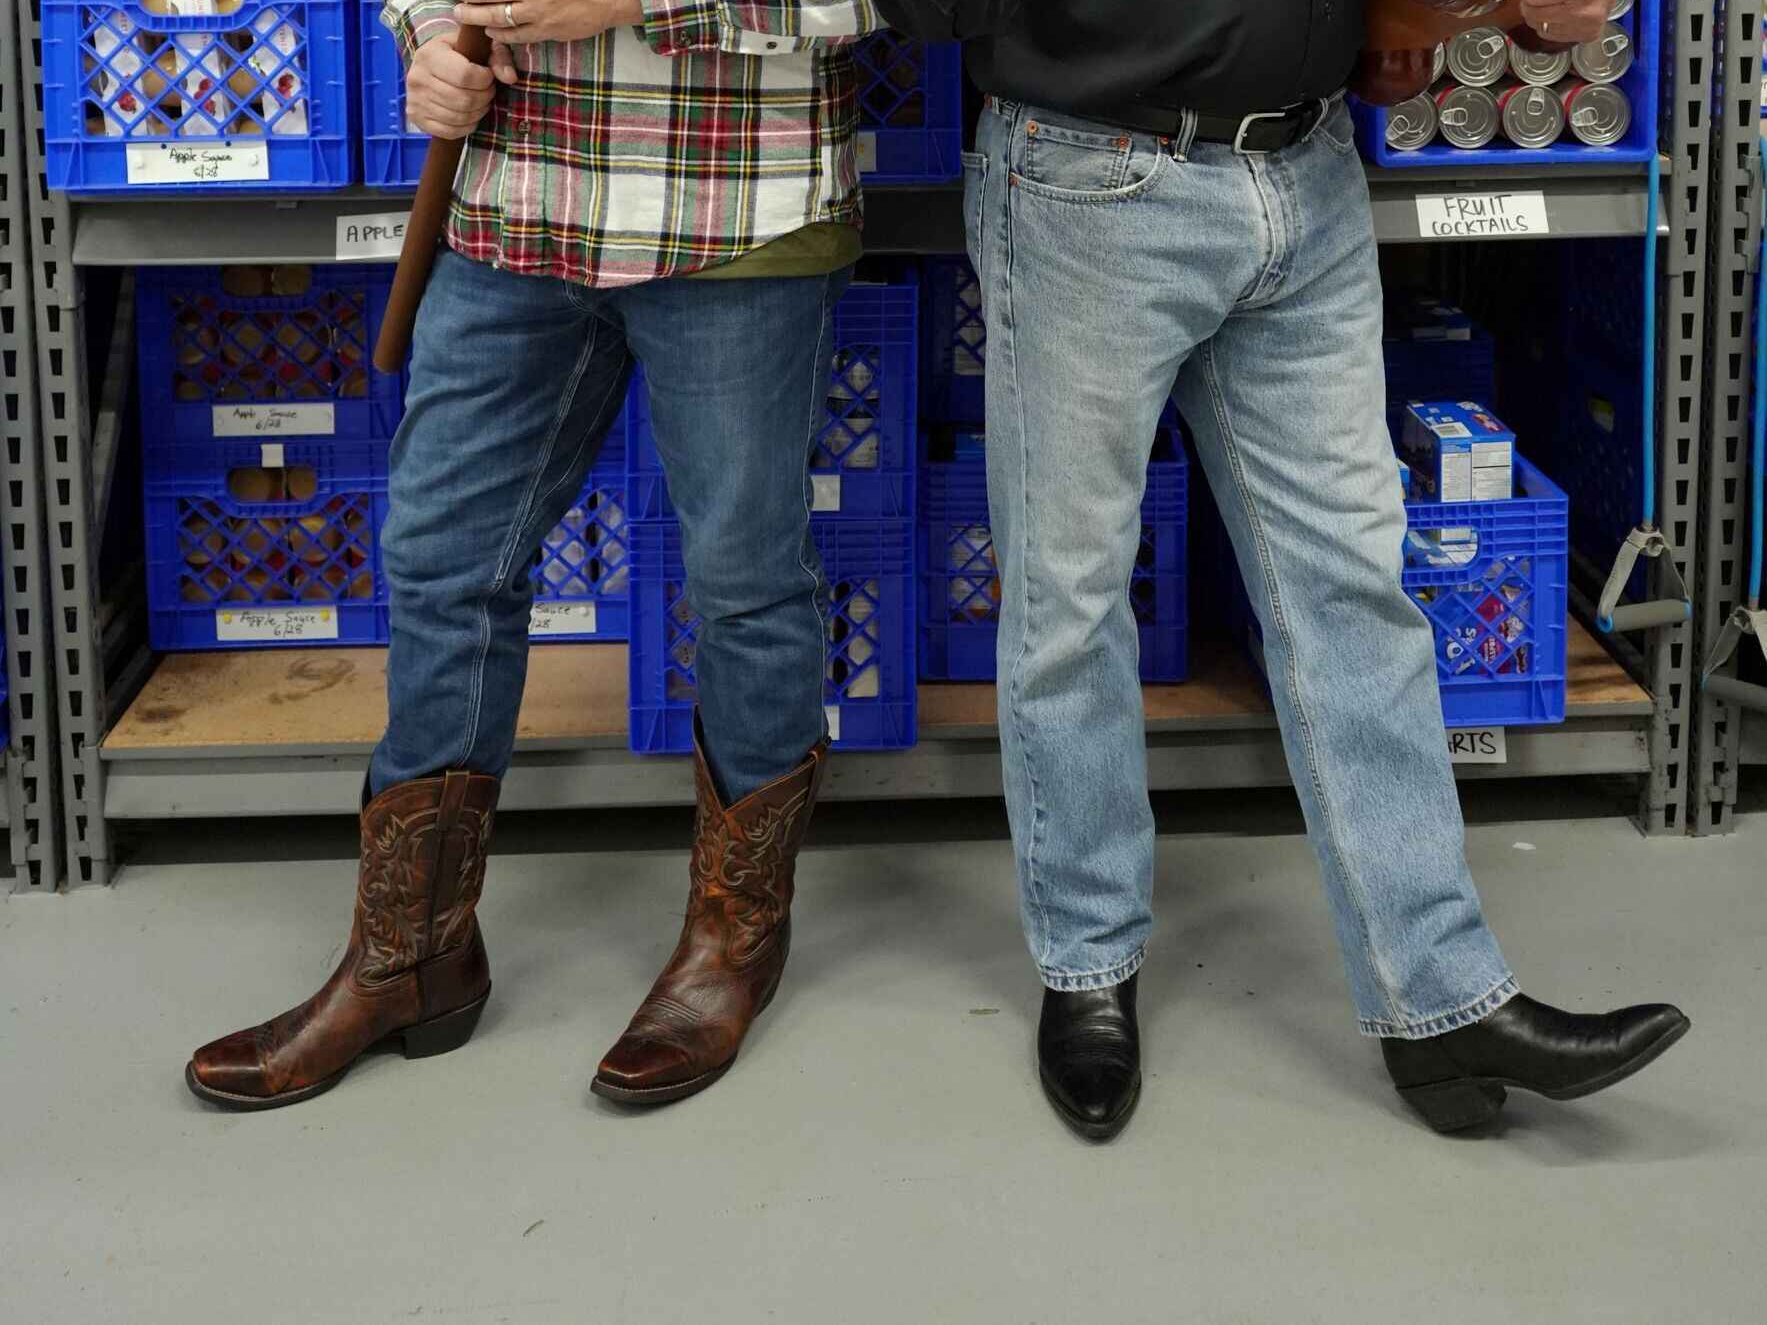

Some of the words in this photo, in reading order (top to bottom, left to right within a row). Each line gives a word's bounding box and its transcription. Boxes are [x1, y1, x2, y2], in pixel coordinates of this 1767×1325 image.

[1443, 194, 1513, 220] FRUIT
[346, 225, 404, 243] APPLE
[1431, 214, 1529, 236] COCKTAILS
